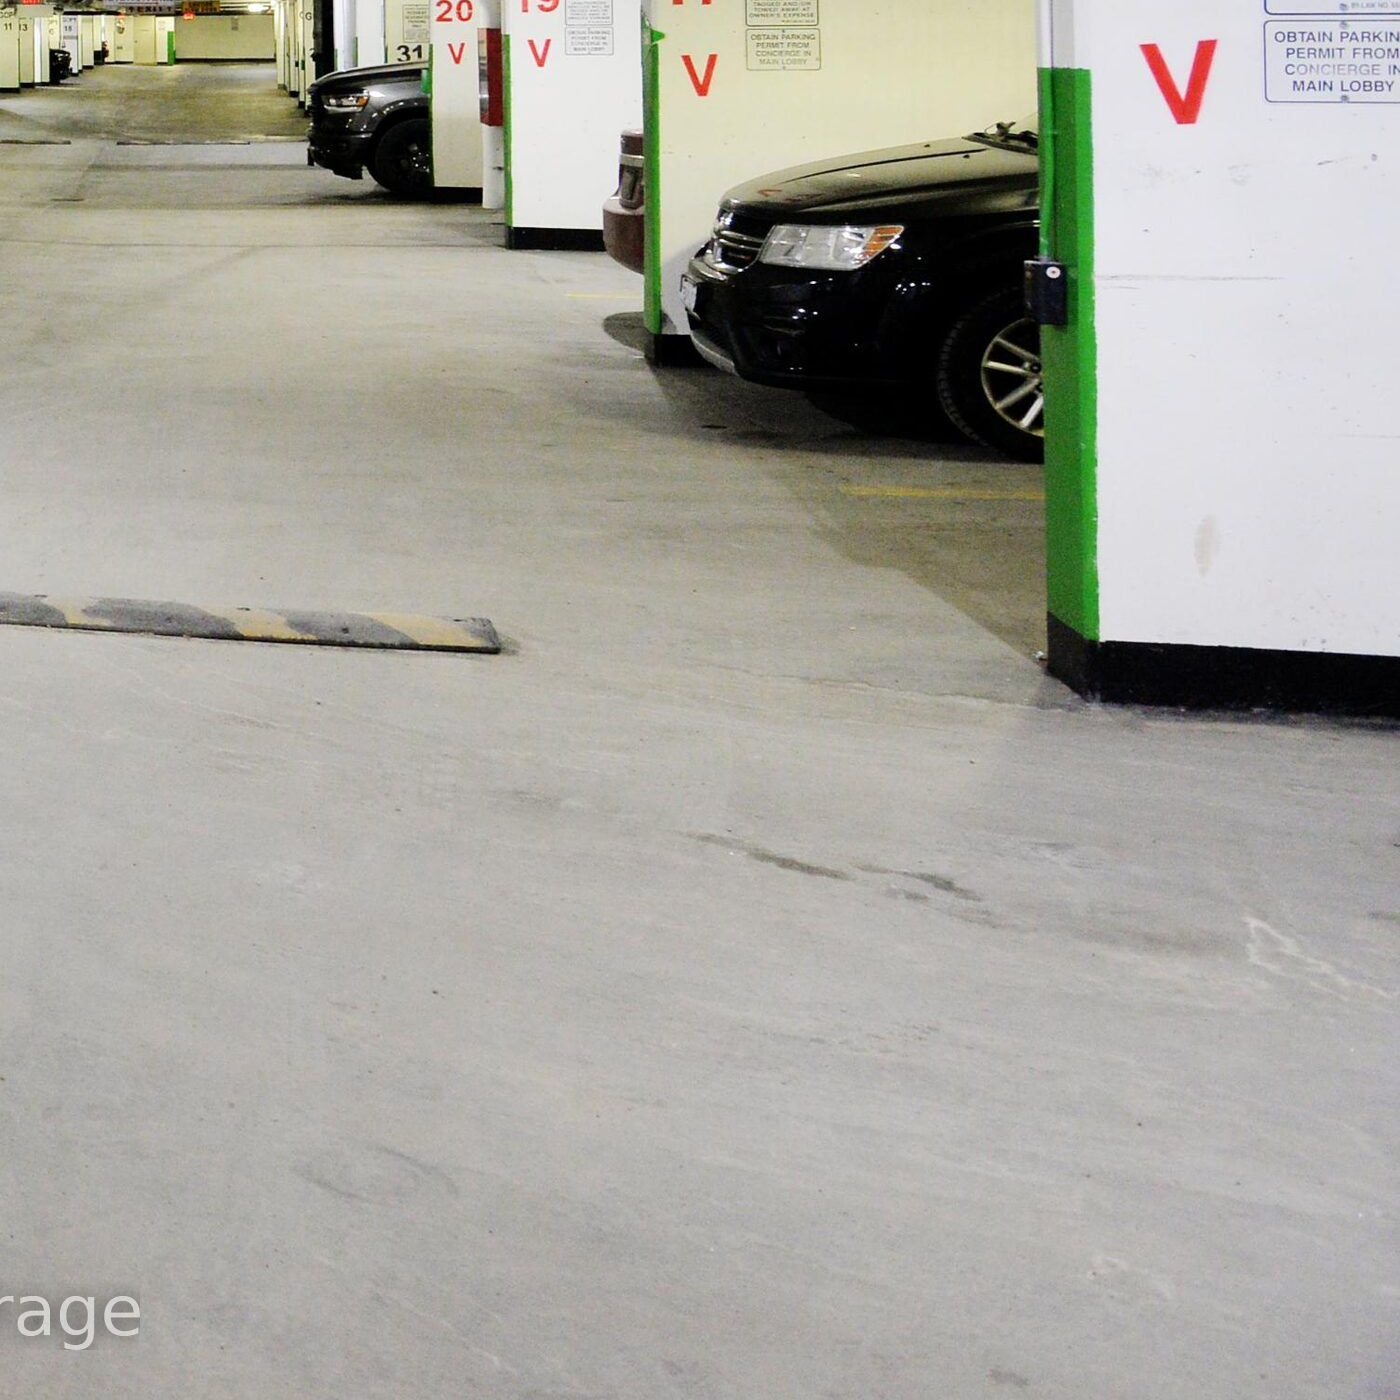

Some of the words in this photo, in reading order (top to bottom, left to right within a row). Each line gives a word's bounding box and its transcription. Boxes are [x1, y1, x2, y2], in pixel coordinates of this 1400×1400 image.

[435, 0, 473, 22] 20
[4, 22, 12, 30] 11
[1274, 31, 1333, 43] OBTAIN
[396, 44, 423, 62] 31
[447, 42, 465, 65] V
[527, 39, 551, 68] V
[1286, 47, 1345, 59] PERMIT
[1352, 47, 1400, 59] FROM
[681, 54, 718, 97] V
[1285, 64, 1380, 75] CONCIERGE
[1139, 39, 1218, 125] V
[1292, 80, 1333, 91] MAIN
[1340, 80, 1394, 91] LOBBY
